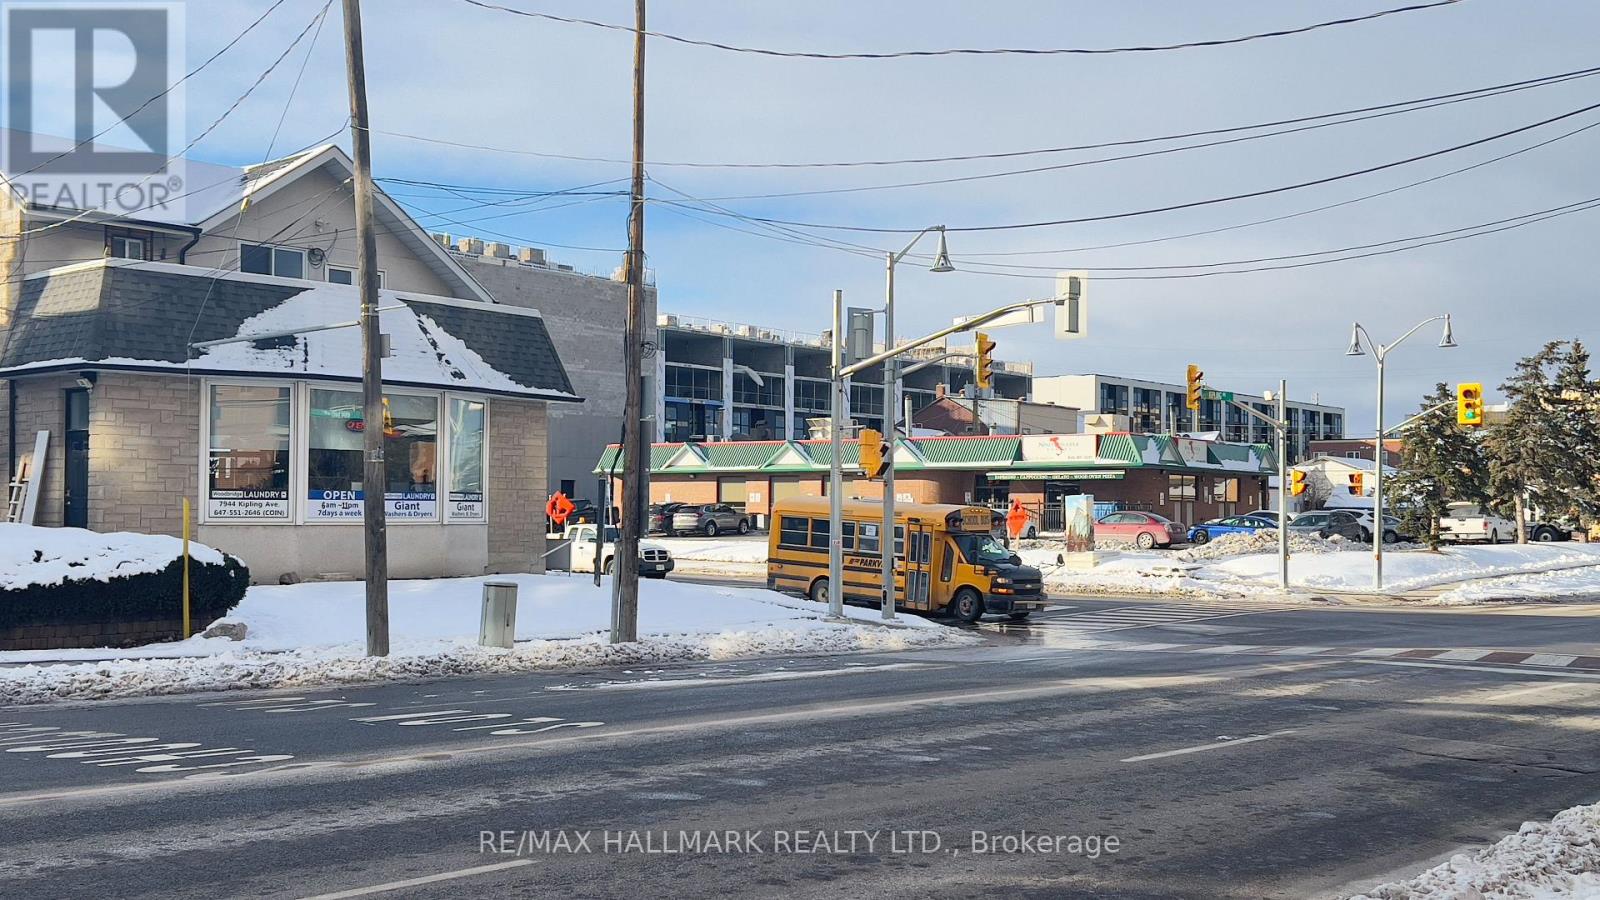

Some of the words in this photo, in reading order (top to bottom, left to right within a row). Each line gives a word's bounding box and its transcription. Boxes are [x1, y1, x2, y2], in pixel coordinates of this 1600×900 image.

[323, 490, 356, 500] OPEN
[402, 492, 431, 500] LAUNDRY
[322, 501, 337, 509] 6am
[395, 502, 420, 511] Giant
[457, 503, 475, 512] Giant
[263, 509, 285, 517] (COIN)
[318, 509, 337, 517] 7days
[860, 558, 883, 568] PARKV
